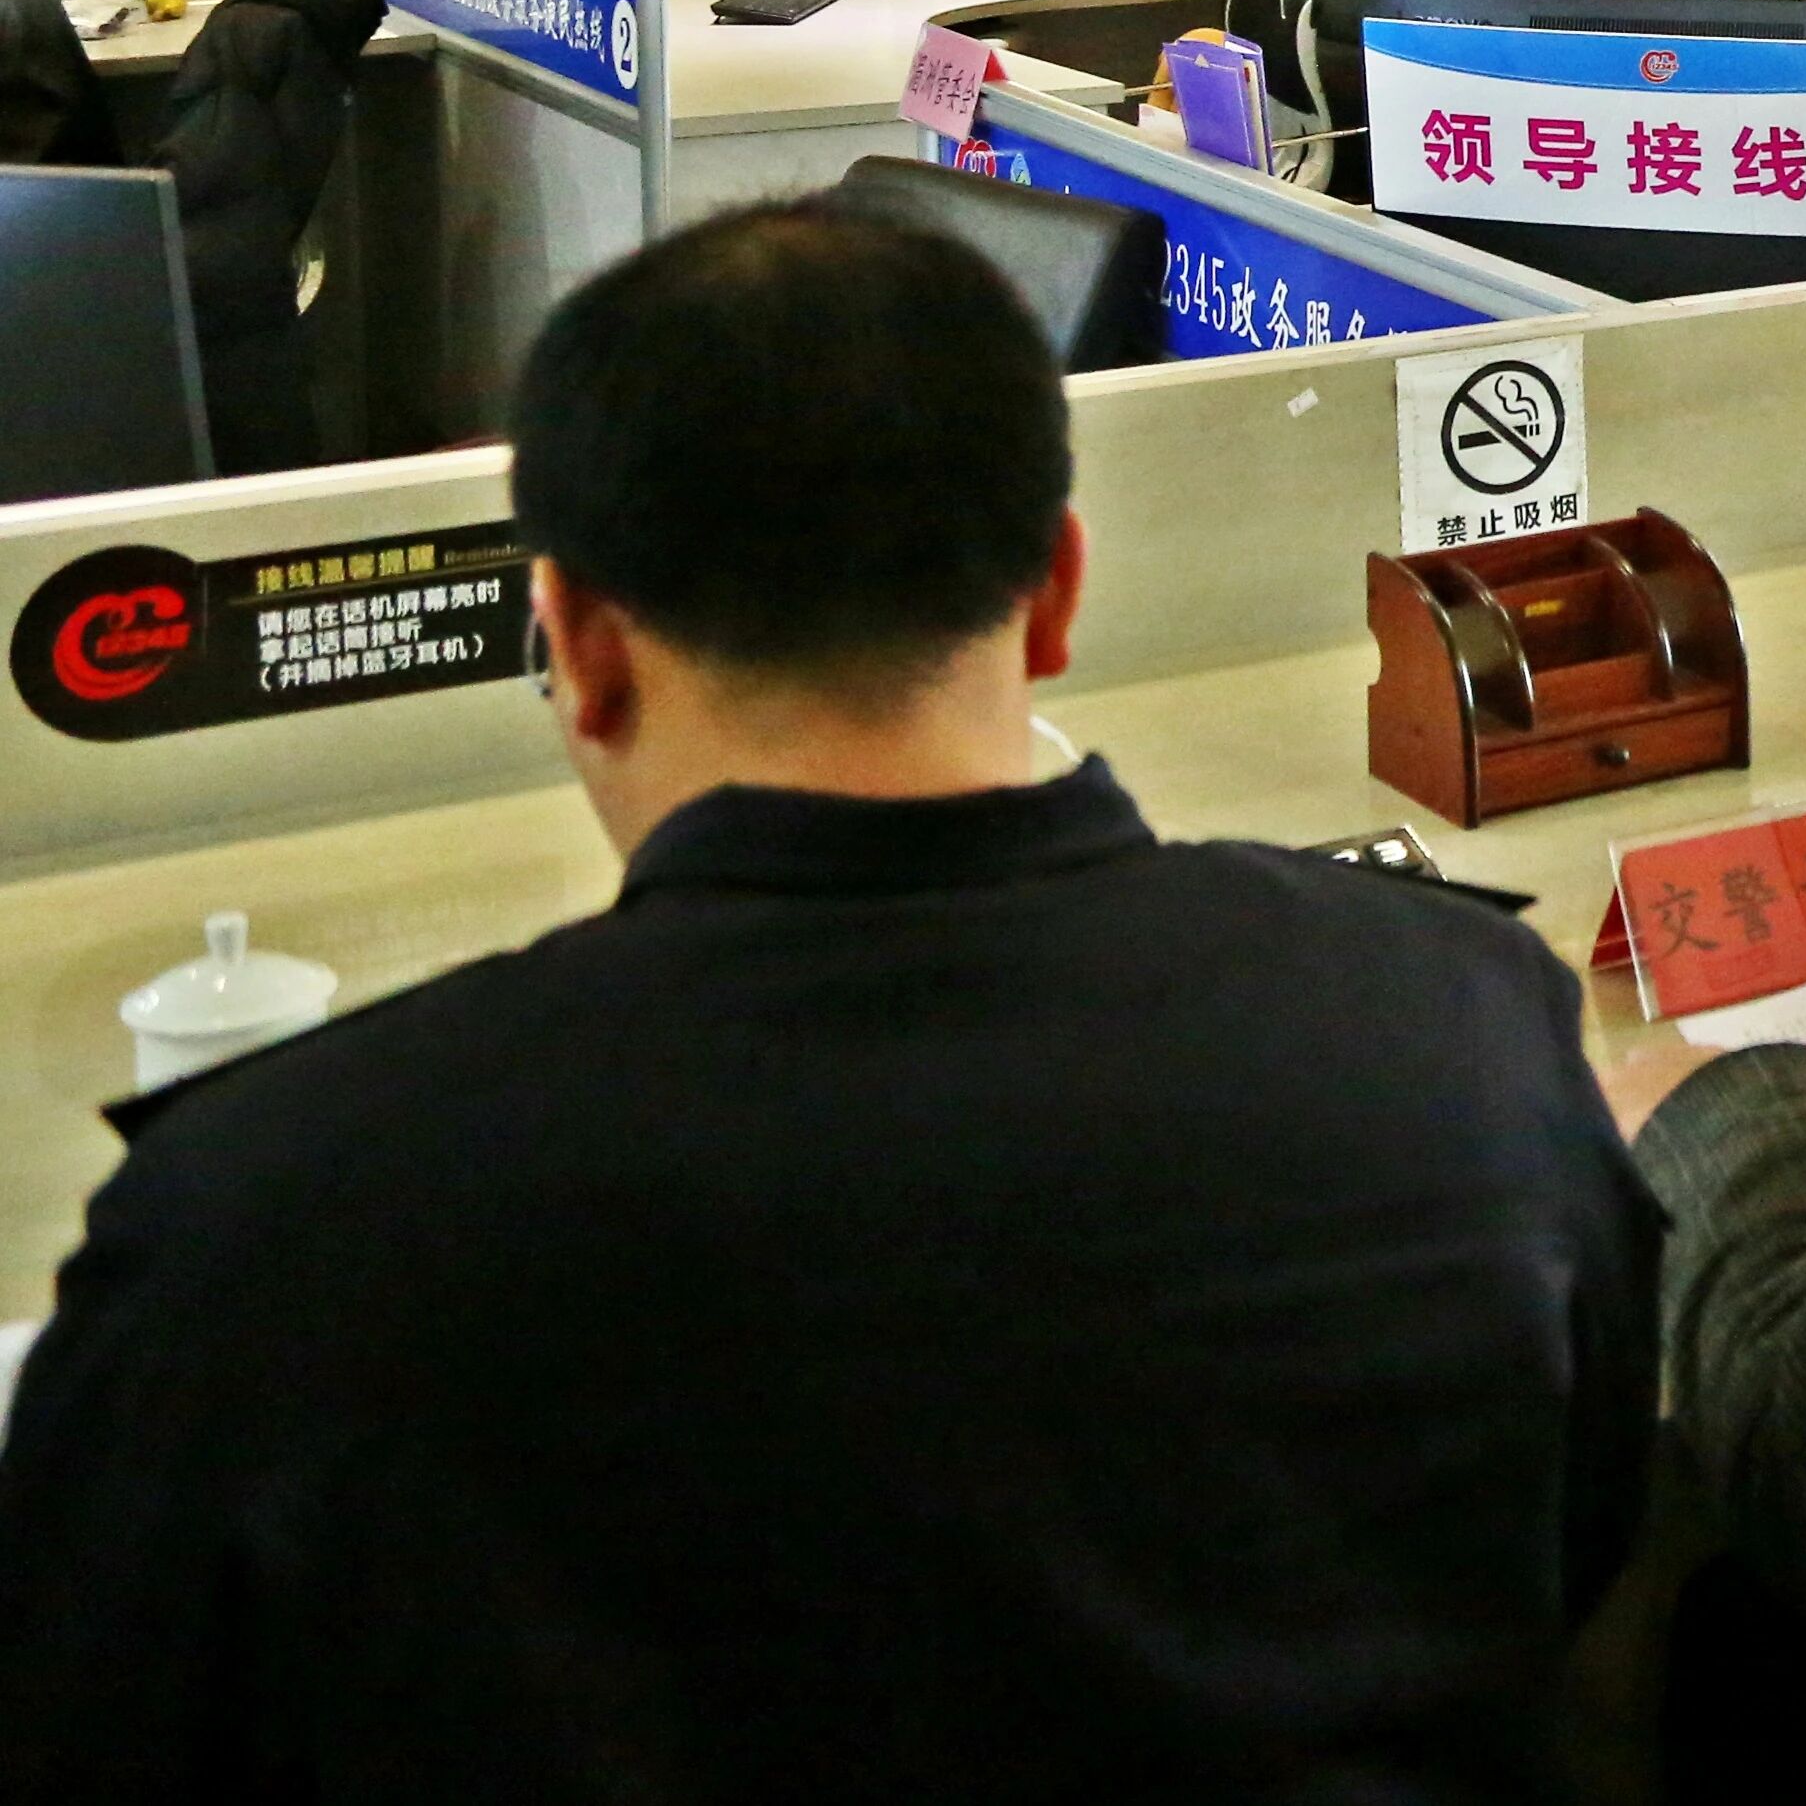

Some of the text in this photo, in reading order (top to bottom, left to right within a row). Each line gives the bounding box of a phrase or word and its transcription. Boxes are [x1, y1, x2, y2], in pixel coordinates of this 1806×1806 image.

[621, 18, 633, 72] 2
[1437, 493, 1577, 546] 禁止吸烟
[444, 544, 522, 565] Reminde
